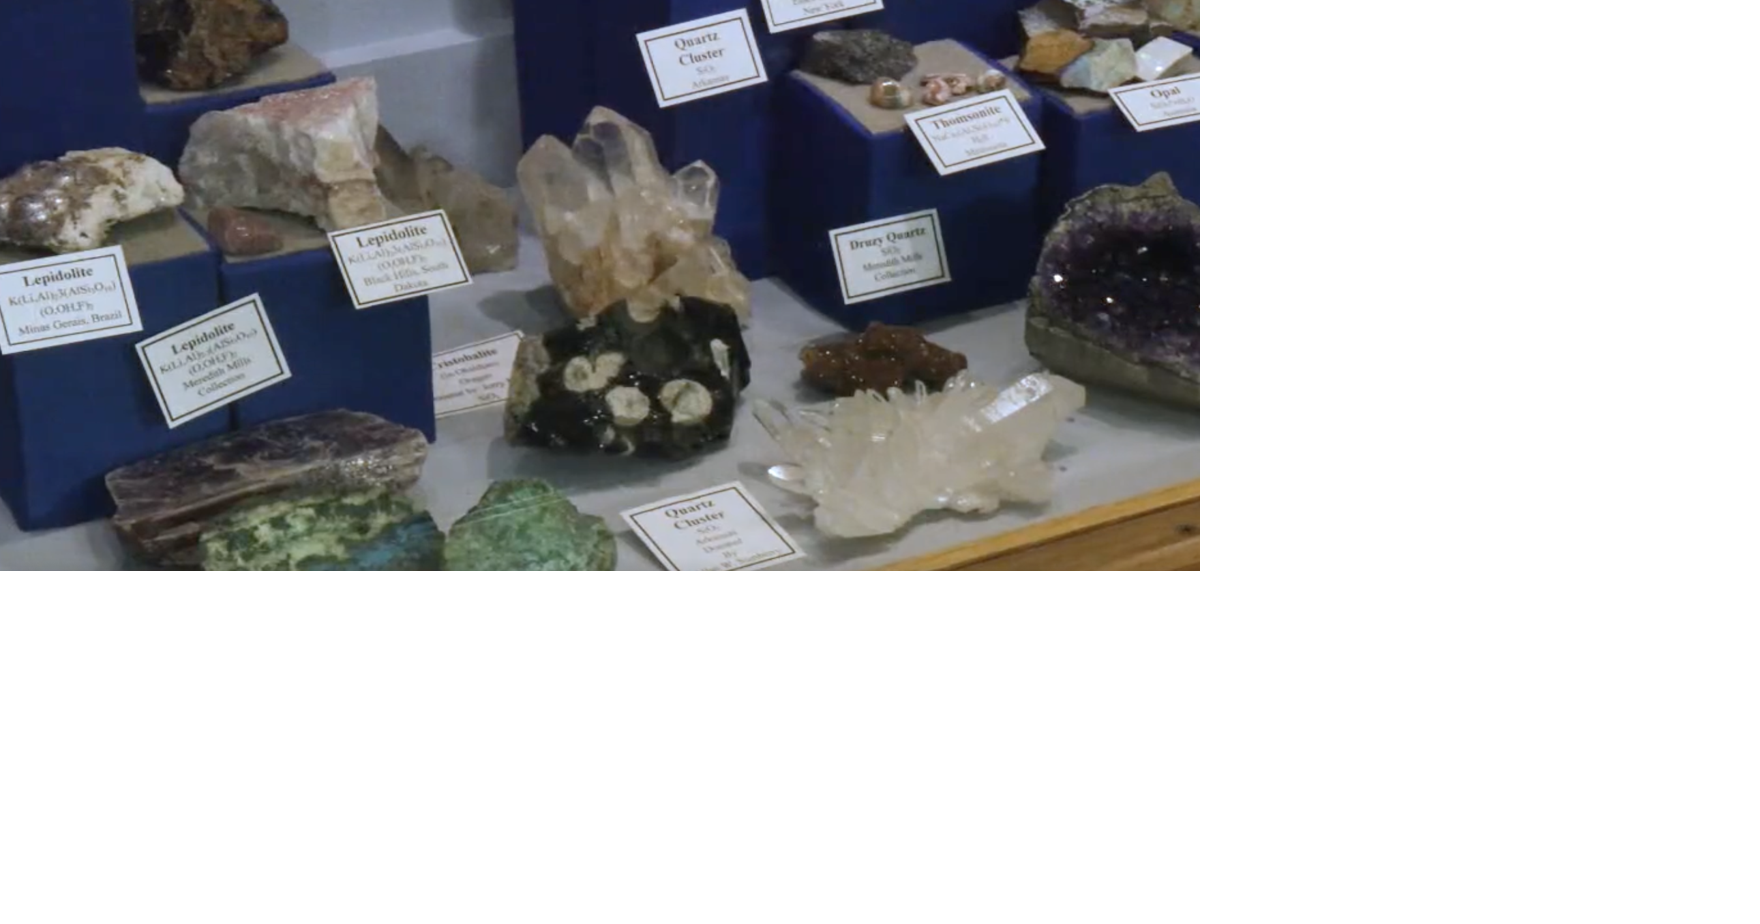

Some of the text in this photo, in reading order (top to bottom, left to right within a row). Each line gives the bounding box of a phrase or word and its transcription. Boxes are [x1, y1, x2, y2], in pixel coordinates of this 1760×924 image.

[674, 32, 720, 50] Quartz
[679, 48, 725, 66] Cluster
[1150, 86, 1181, 99] Opal
[930, 105, 1002, 130] Thomsonite
[356, 225, 427, 248] Lepidolite
[849, 227, 927, 250] Druzy Quartz
[23, 266, 94, 287] Lepidolite
[363, 272, 390, 287] Black
[874, 267, 916, 281] Collection
[393, 280, 428, 292] Dakota
[18, 322, 50, 336] Minas
[91, 310, 122, 323] Brazil
[171, 322, 235, 355] Lepidolite
[182, 357, 252, 391] Meredith Mills
[197, 373, 246, 397] Collection
[665, 499, 715, 519] Quartz
[673, 511, 725, 531] Cluster
